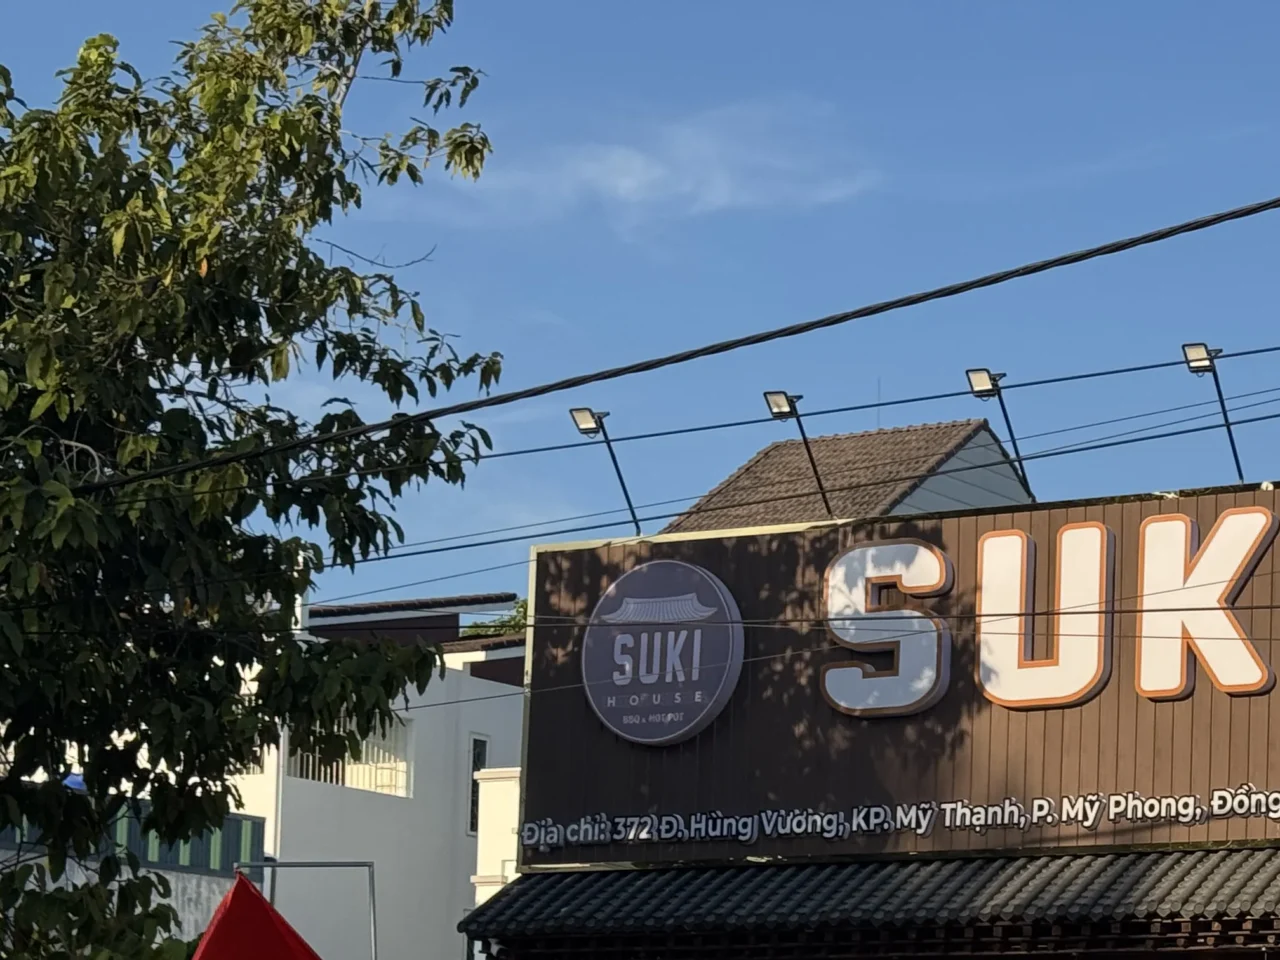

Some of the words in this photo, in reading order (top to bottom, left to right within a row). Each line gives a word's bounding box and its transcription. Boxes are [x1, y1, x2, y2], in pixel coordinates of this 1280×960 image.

[613, 629, 702, 685] SUKI
[607, 691, 703, 707] HOUSE
[521, 821, 559, 846] Địa
[613, 816, 652, 840] 372
[660, 815, 683, 840] Đ.
[691, 811, 752, 842] Hùng
[852, 806, 889, 832] KP.
[896, 802, 933, 834] Mỹ
[941, 799, 1027, 833] Thạnh,
[1032, 798, 1054, 825] P.
[1062, 794, 1101, 828] Mỹ
[1108, 793, 1202, 823] Phong,
